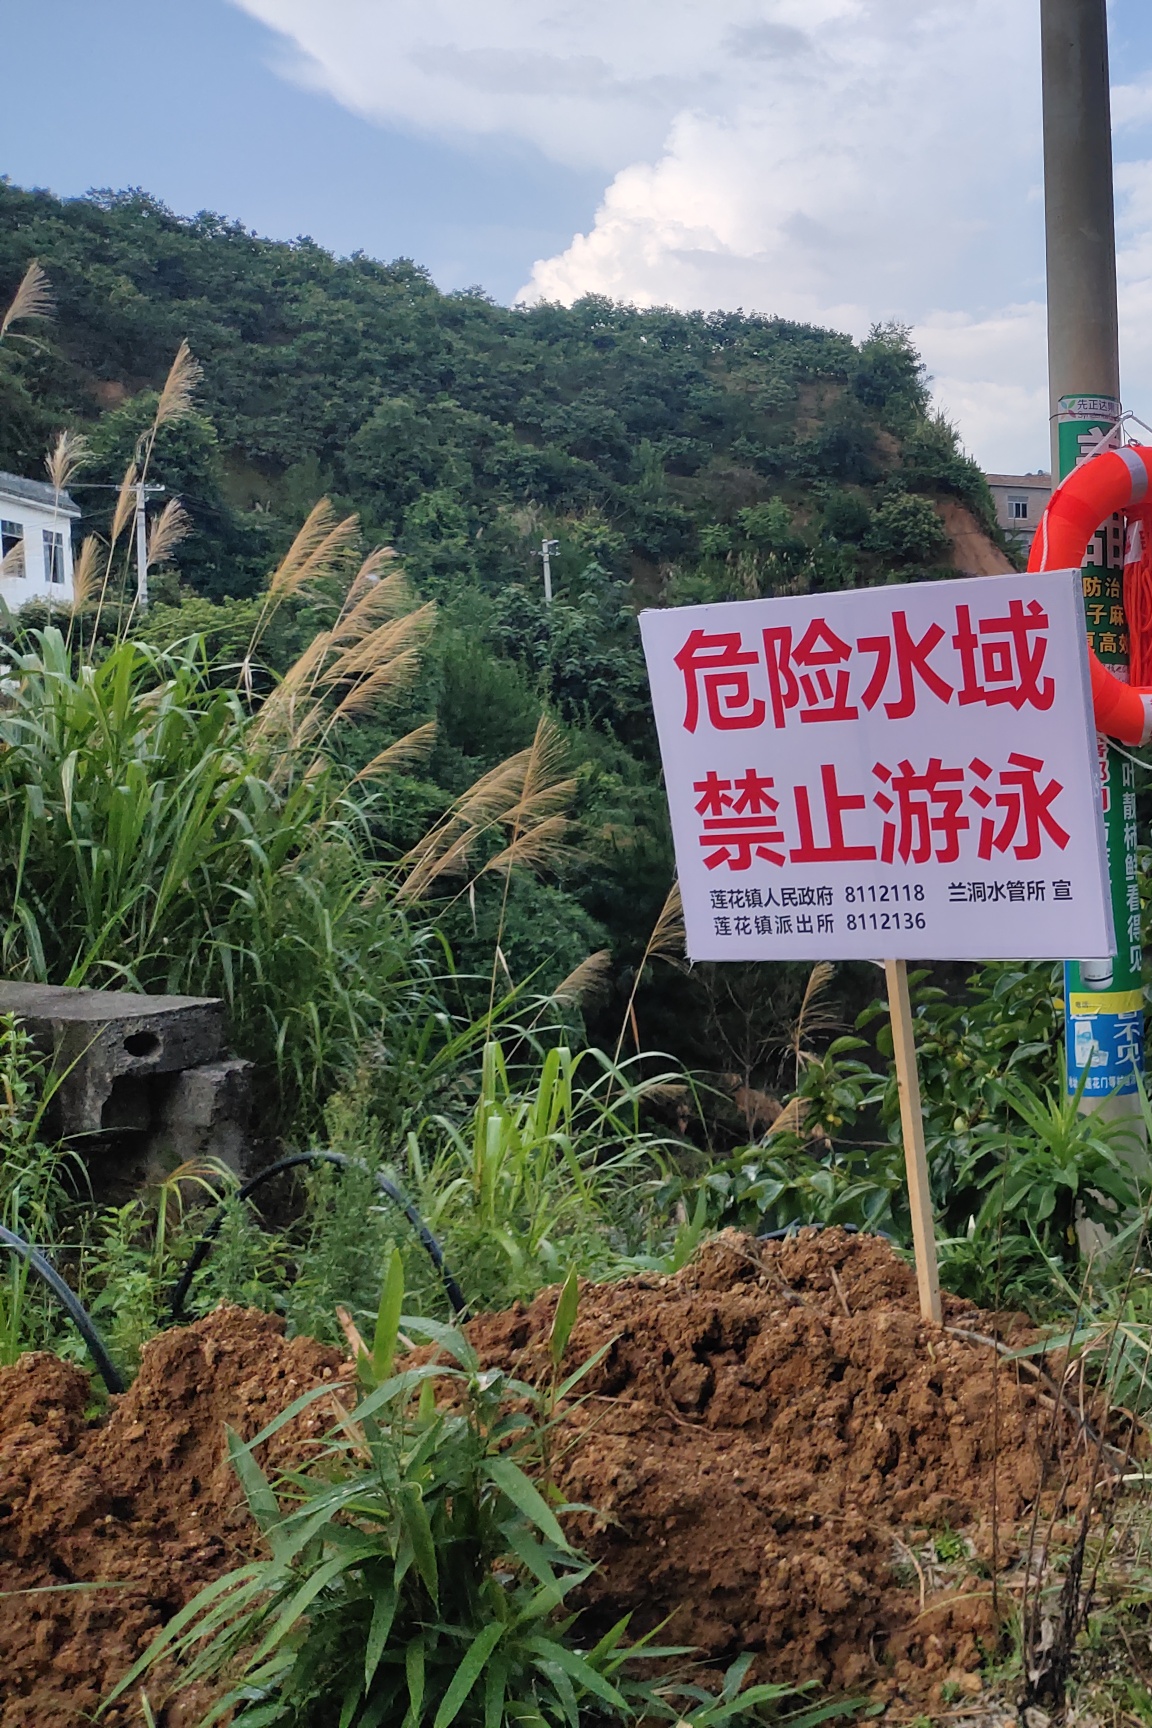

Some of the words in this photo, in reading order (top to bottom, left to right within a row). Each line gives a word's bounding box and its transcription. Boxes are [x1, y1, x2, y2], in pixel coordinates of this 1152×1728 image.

[1082, 576, 1120, 598] 防治
[673, 599, 1055, 734] 危险水域
[693, 752, 1071, 871] 禁止游泳
[709, 886, 834, 909] 莲花镇人民政府
[845, 884, 925, 902] 8112118
[948, 880, 1046, 902] 兰洞水管所
[1052, 879, 1073, 901] 宣
[713, 914, 835, 936] 莲花镇派出所
[847, 912, 926, 930] 8112136
